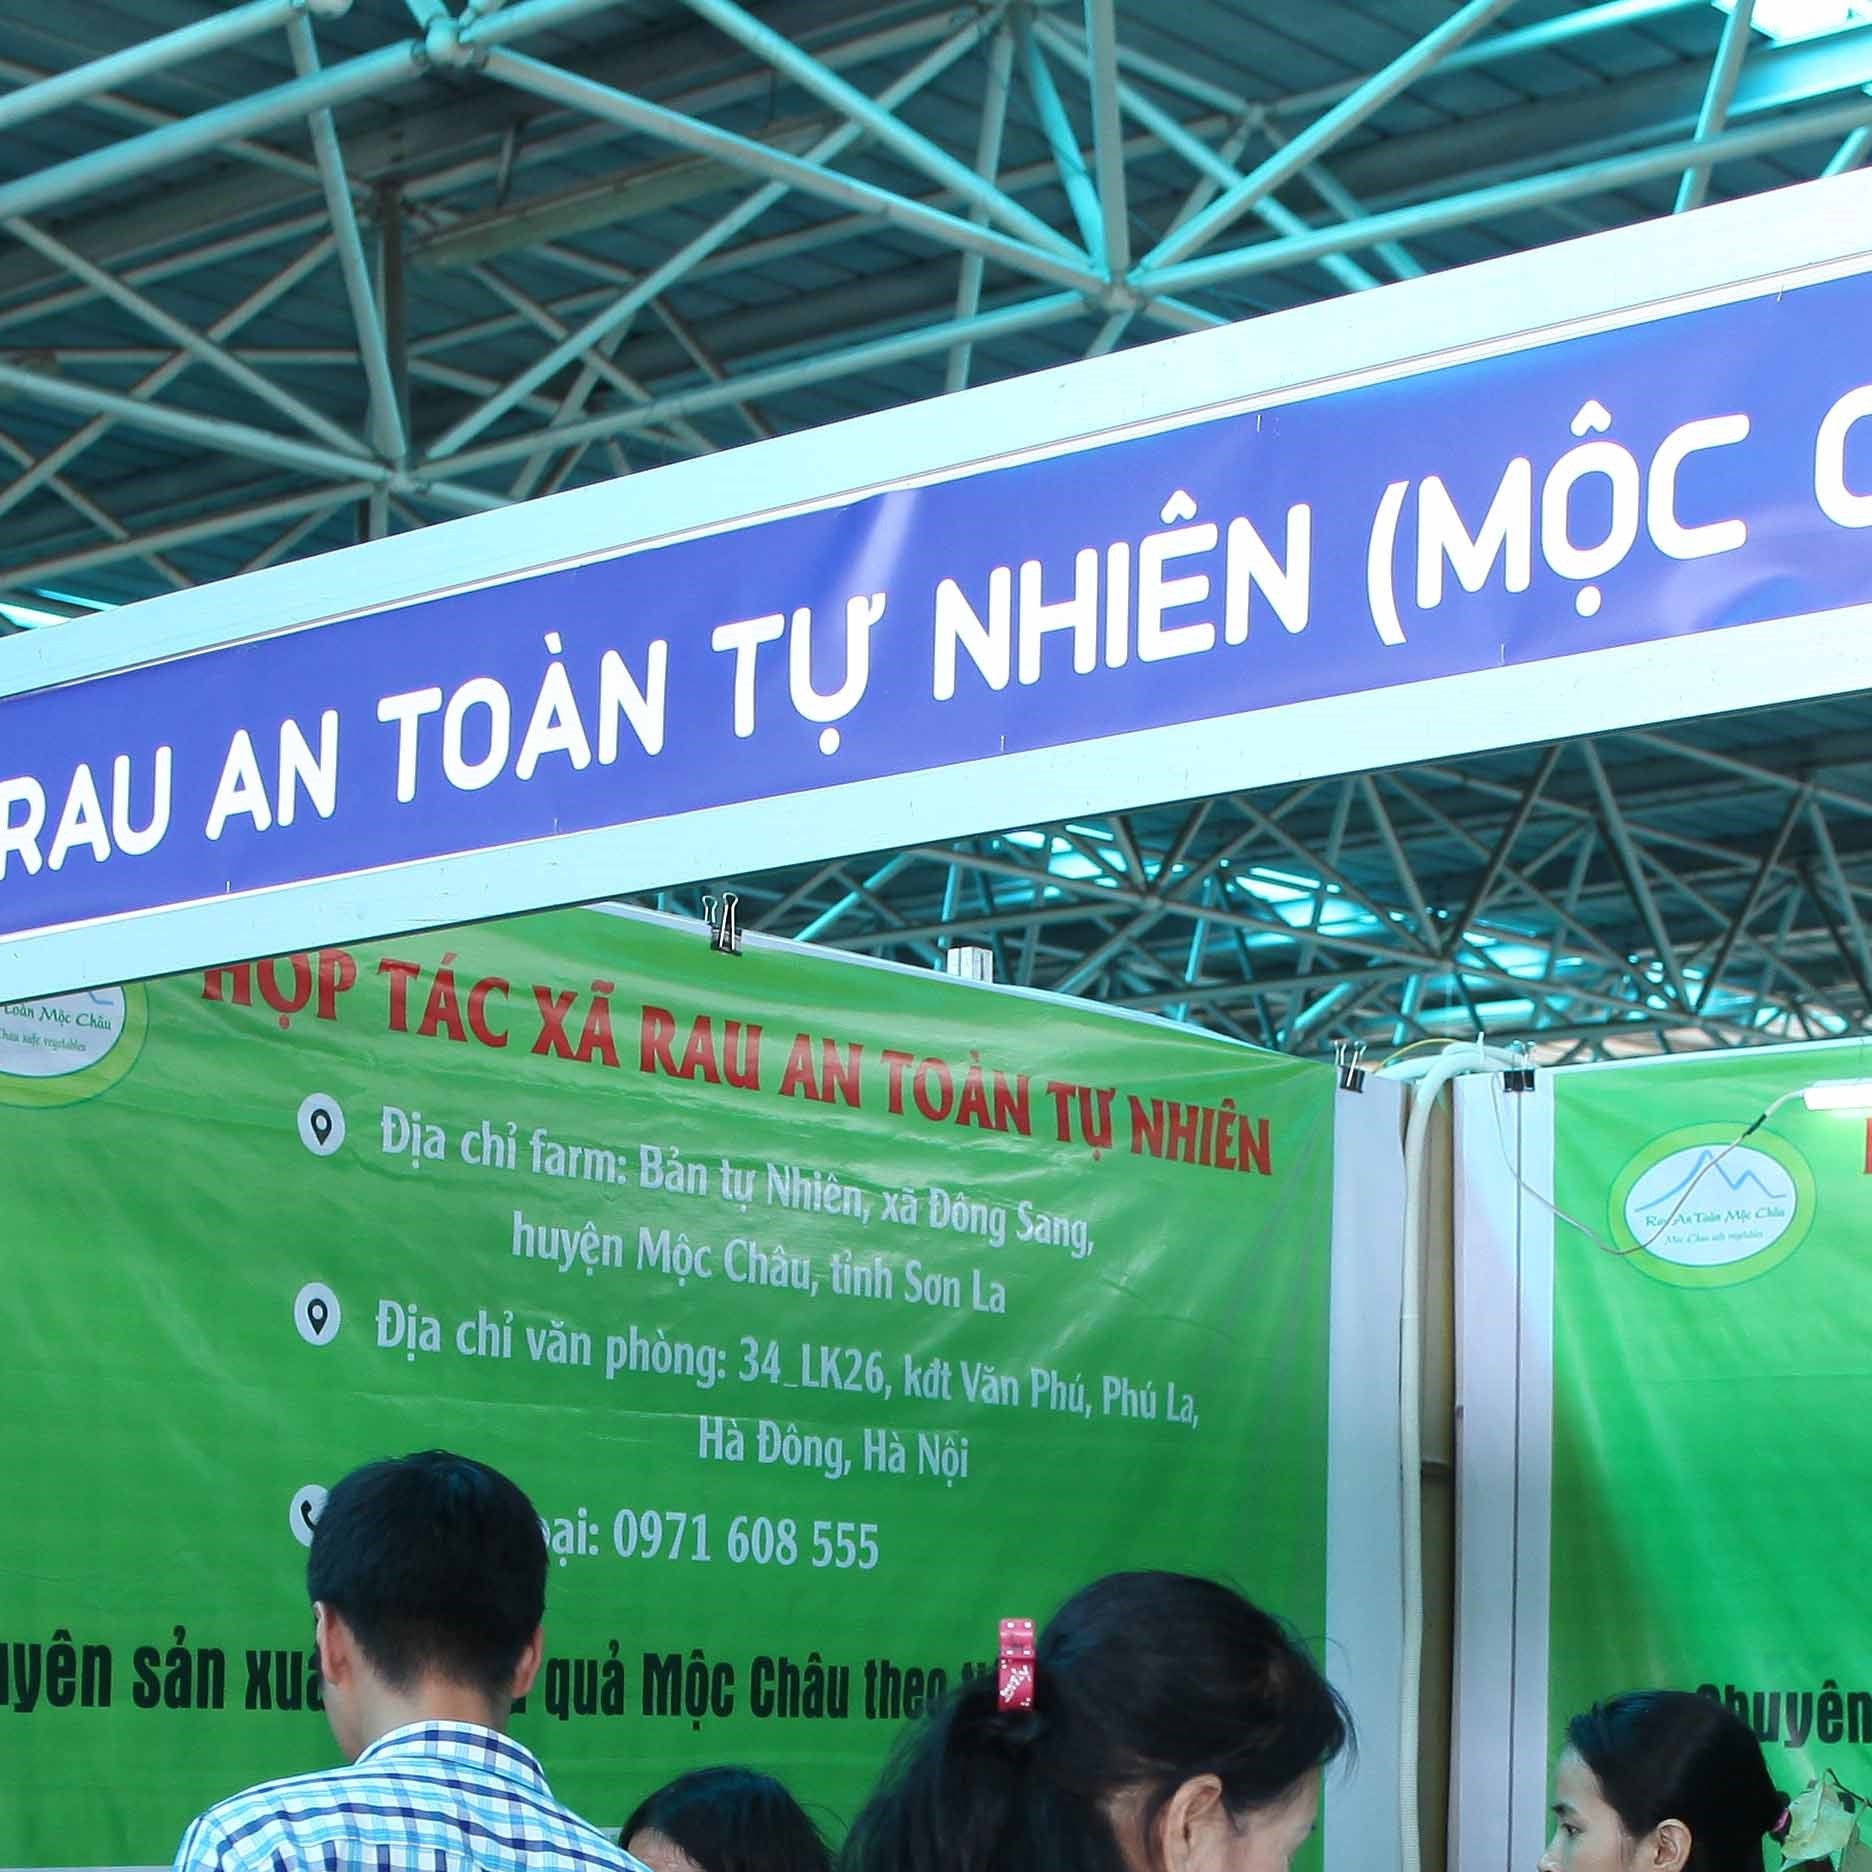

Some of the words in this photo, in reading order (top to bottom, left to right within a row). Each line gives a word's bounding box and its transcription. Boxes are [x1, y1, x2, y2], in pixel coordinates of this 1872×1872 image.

[205, 709, 339, 841] AN
[376, 631, 668, 803] TOÀN
[711, 592, 886, 755] TỰ
[931, 489, 1311, 701] NHIÊN
[1365, 399, 1750, 646] (MỘC
[378, 951, 512, 1049] TÁC
[530, 980, 622, 1068] XÃ
[638, 1005, 764, 1093] RAU
[778, 1032, 865, 1110] AN
[879, 1047, 1035, 1138] TOÀN
[1046, 1080, 1117, 1162] TỰ
[1129, 1095, 1275, 1178] NHIÊN
[379, 1105, 446, 1170] Địa
[459, 1121, 518, 1172] chỉ
[530, 1128, 627, 1184] farm:
[639, 1142, 708, 1198] Bản
[719, 1159, 755, 1209] tự
[767, 1162, 871, 1227] Nhiên,
[881, 1185, 920, 1228] xã
[928, 1187, 1006, 1251] Đông
[1014, 1206, 1095, 1257] Sang,
[513, 1210, 624, 1278] huyện
[636, 1228, 712, 1290] Mộc
[723, 1238, 821, 1298] Châu,
[831, 1252, 894, 1303] tỉnh
[904, 1259, 962, 1310] Sơn
[972, 1269, 1008, 1316] La
[375, 1299, 442, 1363] Địa
[456, 1310, 515, 1360] chỉ
[526, 1321, 592, 1368] văn
[606, 1325, 727, 1389] phòng:
[903, 1356, 954, 1403] kđt
[961, 1360, 1021, 1408] Văn
[1031, 1369, 1093, 1420] Phú,
[1102, 1377, 1158, 1421] Phú
[1165, 1387, 1201, 1431] La,
[698, 1415, 745, 1462] Hà
[756, 1423, 853, 1478] Đông,
[864, 1429, 908, 1475] Hà
[917, 1431, 970, 1488] Nội
[613, 1508, 712, 1564] 0971
[727, 1514, 798, 1566] 608
[811, 1520, 881, 1570] 555
[132, 1625, 225, 1710] sản
[544, 1639, 625, 1716] quả
[641, 1647, 735, 1731] Mộc
[750, 1652, 849, 1719] Châu
